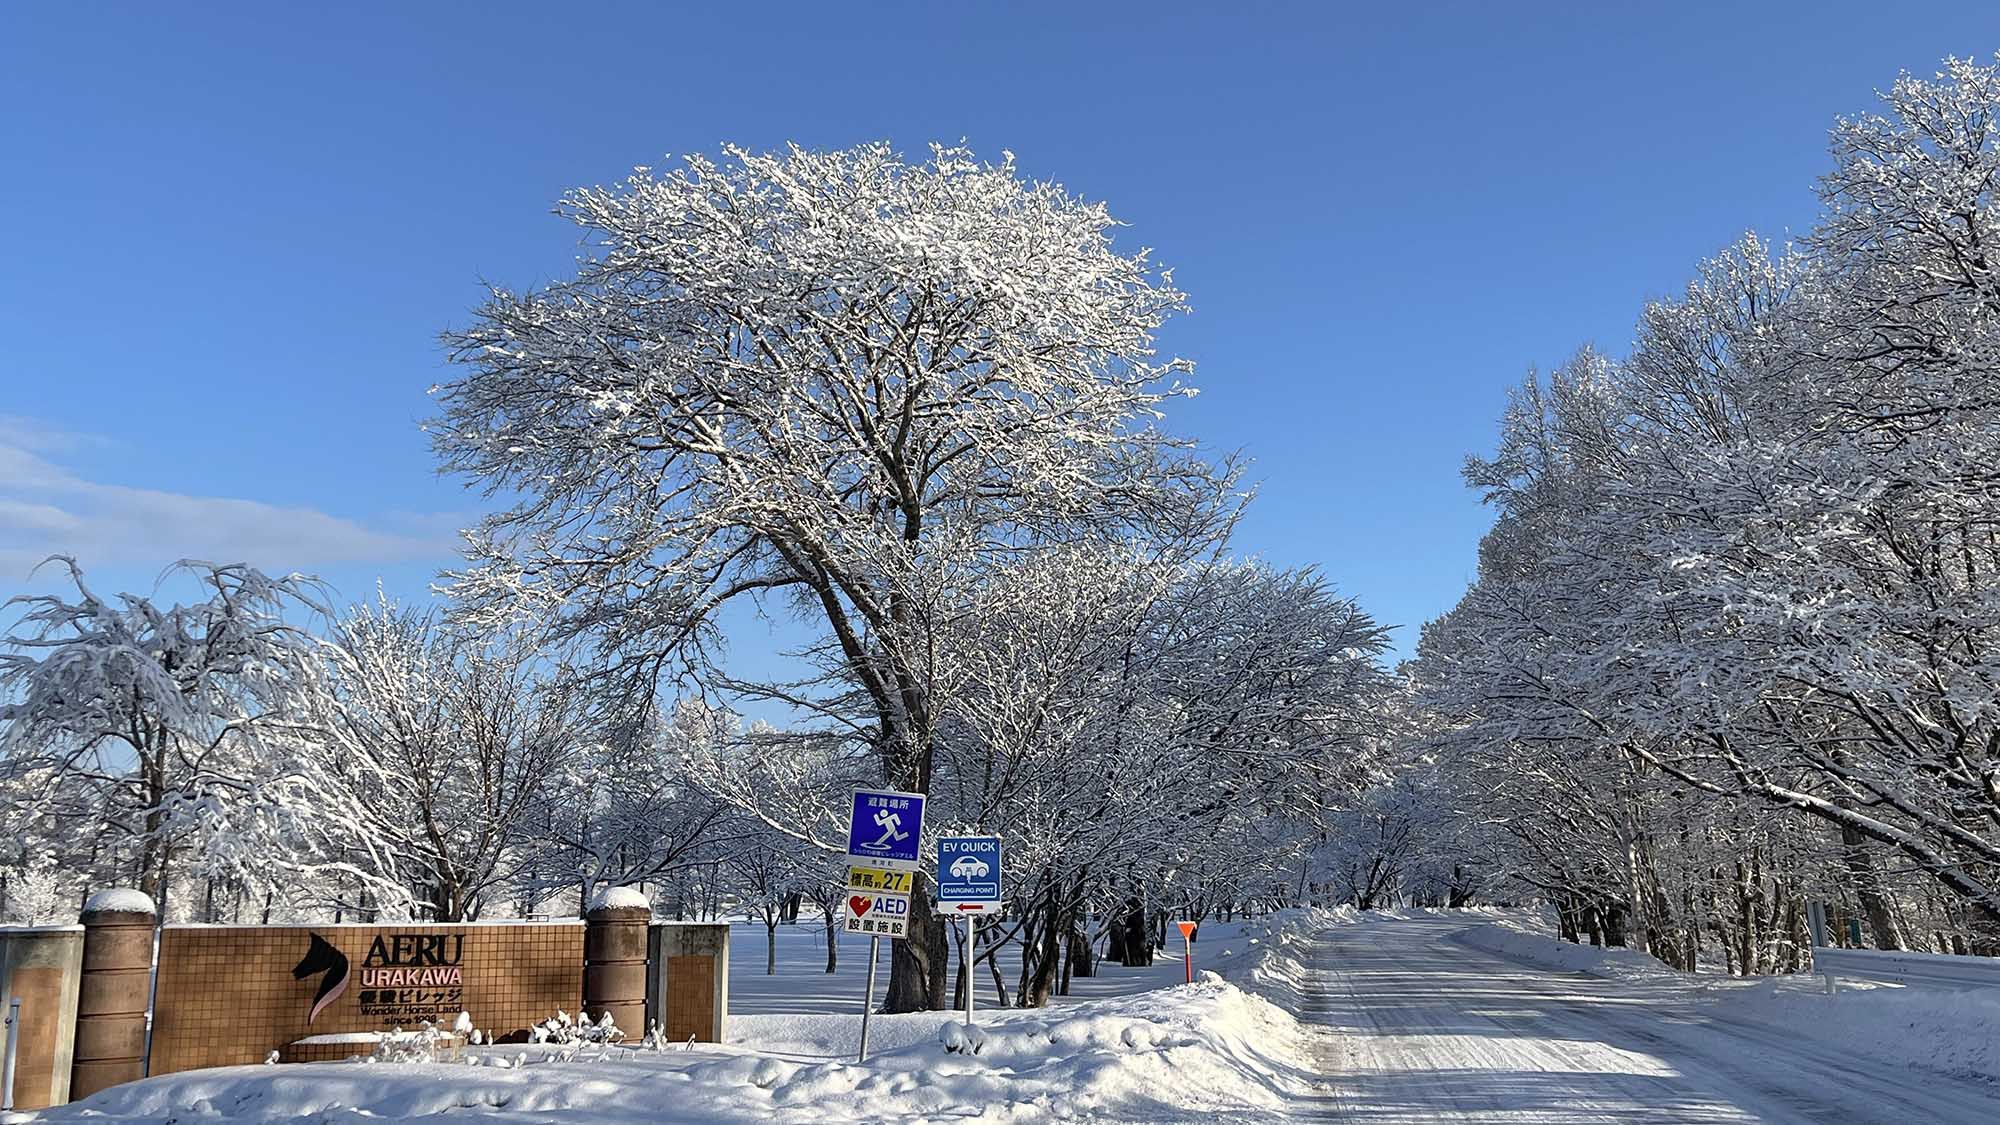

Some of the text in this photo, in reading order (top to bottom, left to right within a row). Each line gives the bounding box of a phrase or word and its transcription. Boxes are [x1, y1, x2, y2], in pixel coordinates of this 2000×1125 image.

[943, 842, 996, 853] EV QUICK
[872, 897, 907, 914] AED
[848, 918, 903, 934] 設置施設
[361, 934, 466, 966] AERU
[361, 968, 462, 986] URAKAWA
[361, 1004, 462, 1015] Wonder Horse Land
[384, 1016, 412, 1024] since
